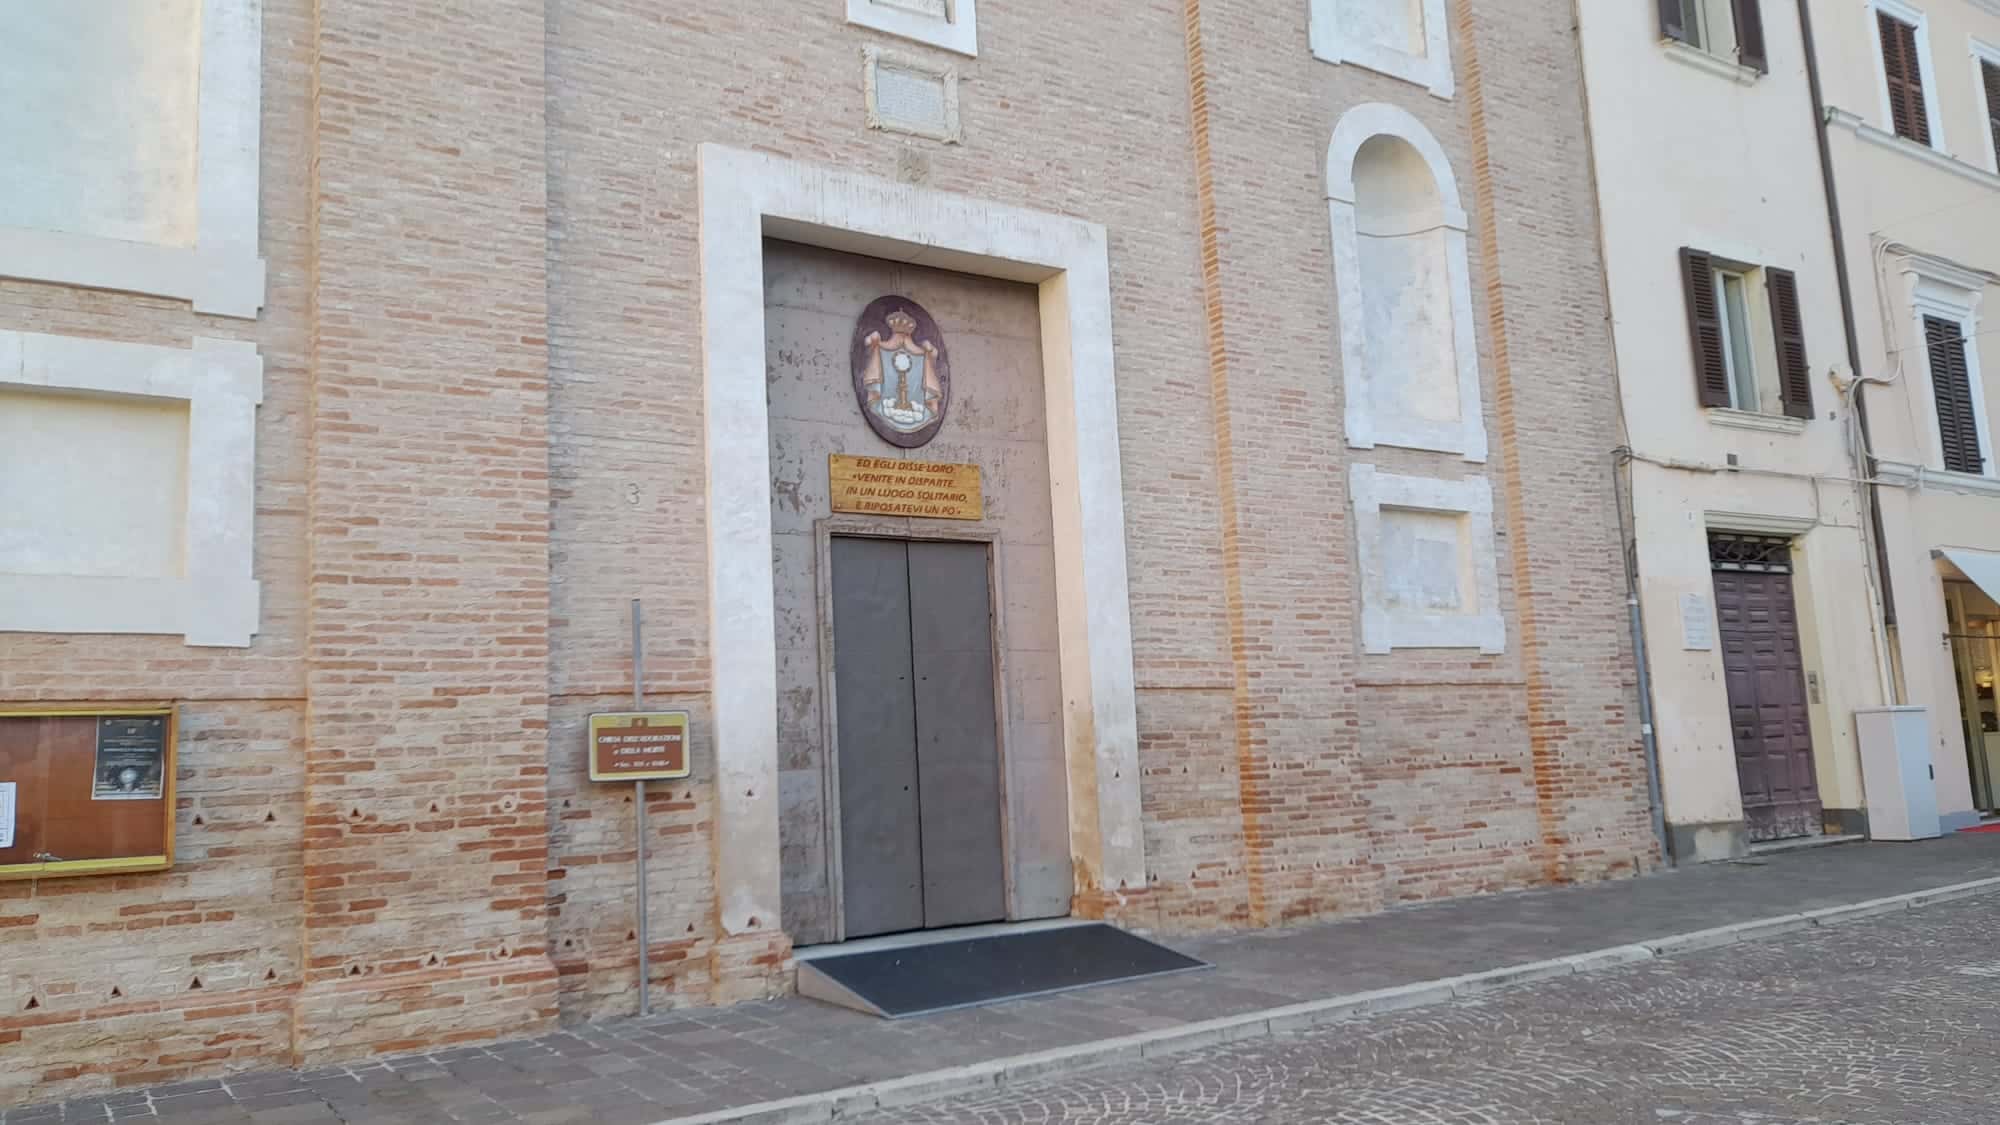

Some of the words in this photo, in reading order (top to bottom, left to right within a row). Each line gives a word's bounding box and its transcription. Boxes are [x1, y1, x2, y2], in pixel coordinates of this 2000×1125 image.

[856, 459, 871, 468] ED
[872, 459, 896, 469] EGLI
[898, 462, 927, 472] DISSE
[895, 475, 907, 485] IN
[846, 486, 858, 496] IN
[860, 487, 876, 497] UN
[878, 488, 914, 498] LUOGO
[864, 502, 922, 513] RIPOSATEVI
[924, 504, 939, 514] UN
